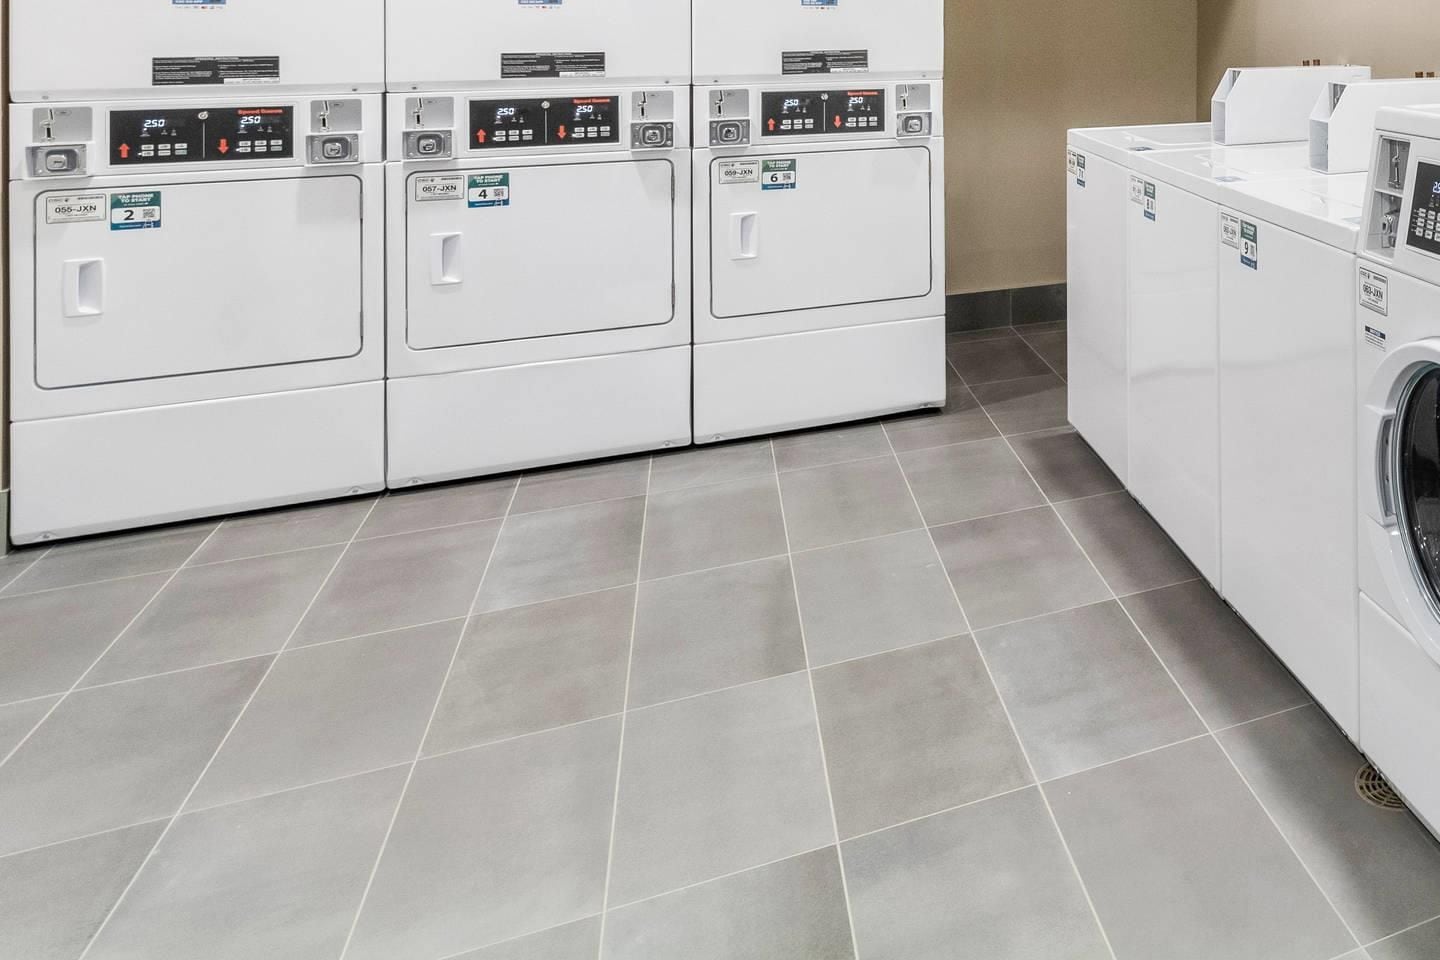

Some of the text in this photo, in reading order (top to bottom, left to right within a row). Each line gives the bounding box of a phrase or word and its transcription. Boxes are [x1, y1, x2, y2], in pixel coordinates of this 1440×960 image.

[771, 173, 778, 182] 6
[478, 189, 488, 199] 4
[55, 205, 97, 213] 055-JXN
[124, 210, 135, 220] 2
[1245, 242, 1248, 254] 9
